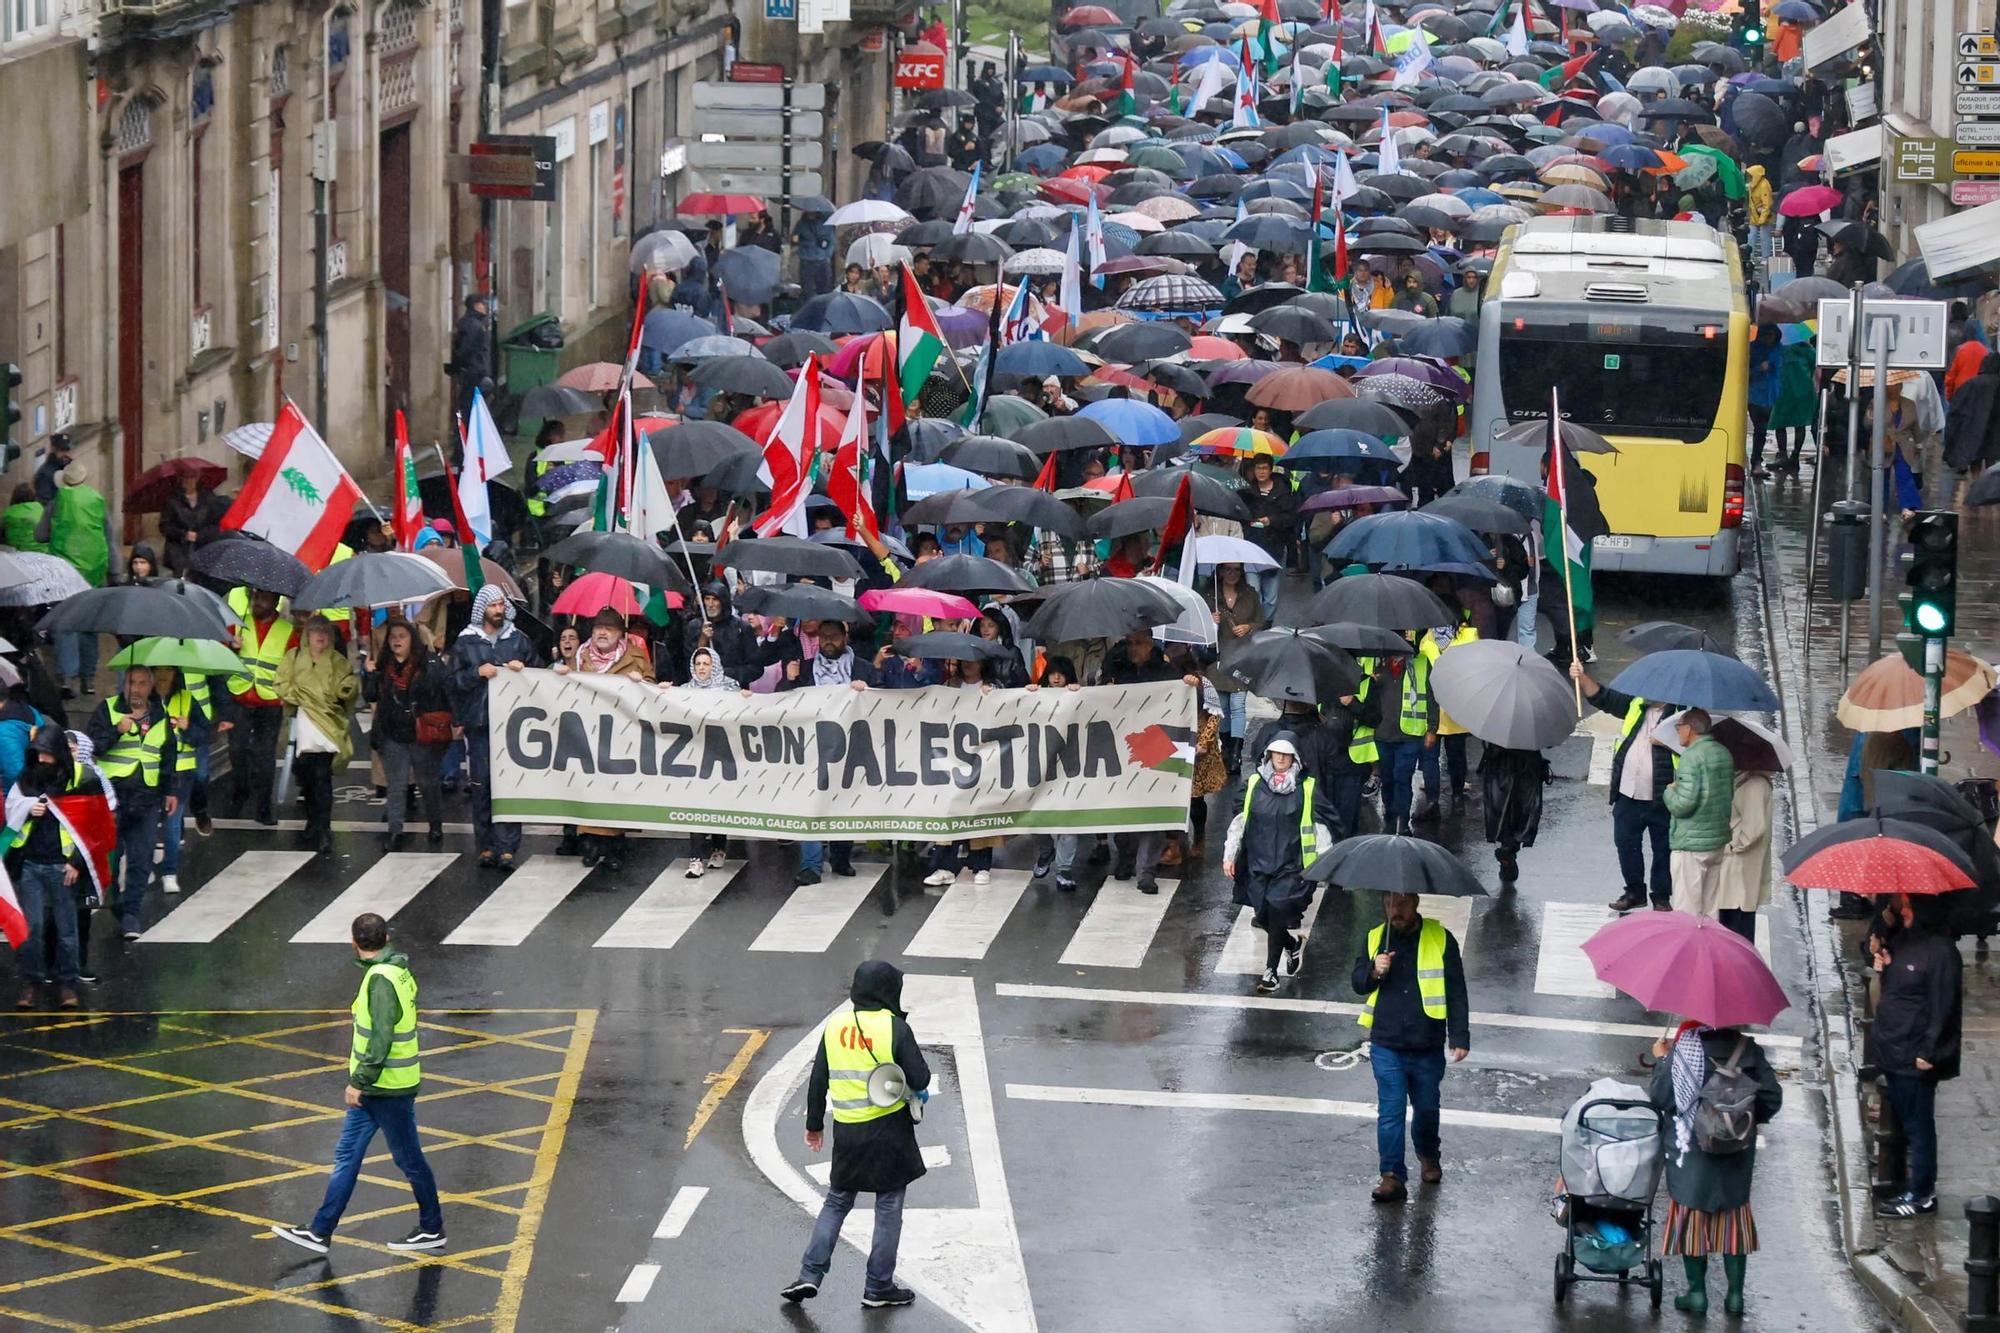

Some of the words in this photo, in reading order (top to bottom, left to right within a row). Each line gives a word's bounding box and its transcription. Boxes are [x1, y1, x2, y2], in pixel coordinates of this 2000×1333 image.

[897, 63, 939, 78] KFC
[1513, 410, 1571, 418] CITAO
[506, 706, 737, 781] GALIZA
[740, 725, 805, 765] CON
[816, 719, 1122, 791] PALESTINA
[669, 811, 764, 827] COORDENADORA
[766, 818, 808, 830] GALEGA
[811, 820, 826, 830] DE
[829, 820, 923, 831] SOLIDARIEDADE
[925, 821, 949, 831] COA
[951, 816, 1014, 831] PALESTINA
